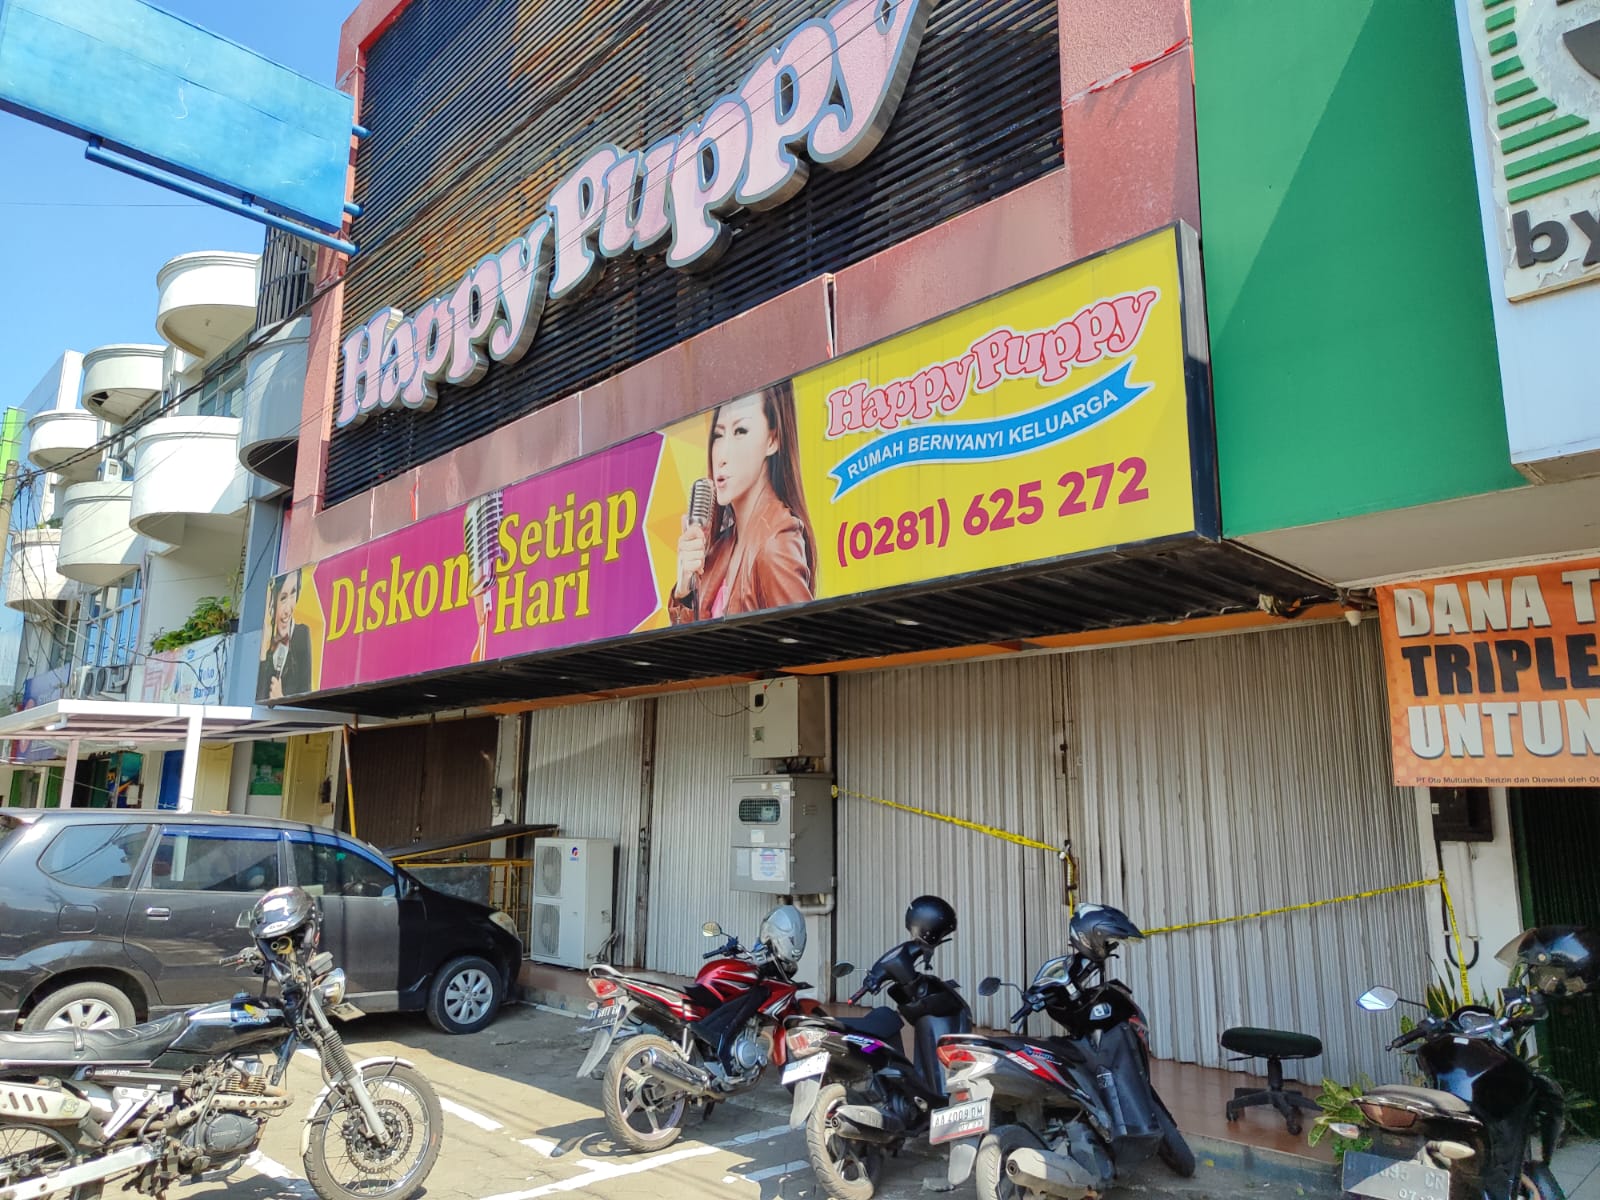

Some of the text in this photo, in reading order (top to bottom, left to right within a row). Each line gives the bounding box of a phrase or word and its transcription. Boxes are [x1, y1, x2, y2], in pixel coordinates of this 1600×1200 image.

[336, 0, 922, 430] Happy Puppy
[827, 290, 1156, 437] Happy Puppy
[847, 389, 1119, 480] RUMAH BERNYANYI KELUARGA
[494, 487, 638, 574] Setiap
[837, 456, 1149, 567] (0281) 625 272
[326, 551, 471, 642] Diskon
[493, 551, 591, 636] Hari
[1393, 575, 1552, 638] DANA
[1401, 633, 1600, 697] TRIPLE
[1407, 698, 1600, 759] UNTUN
[1568, 776, 1587, 784] oleh
